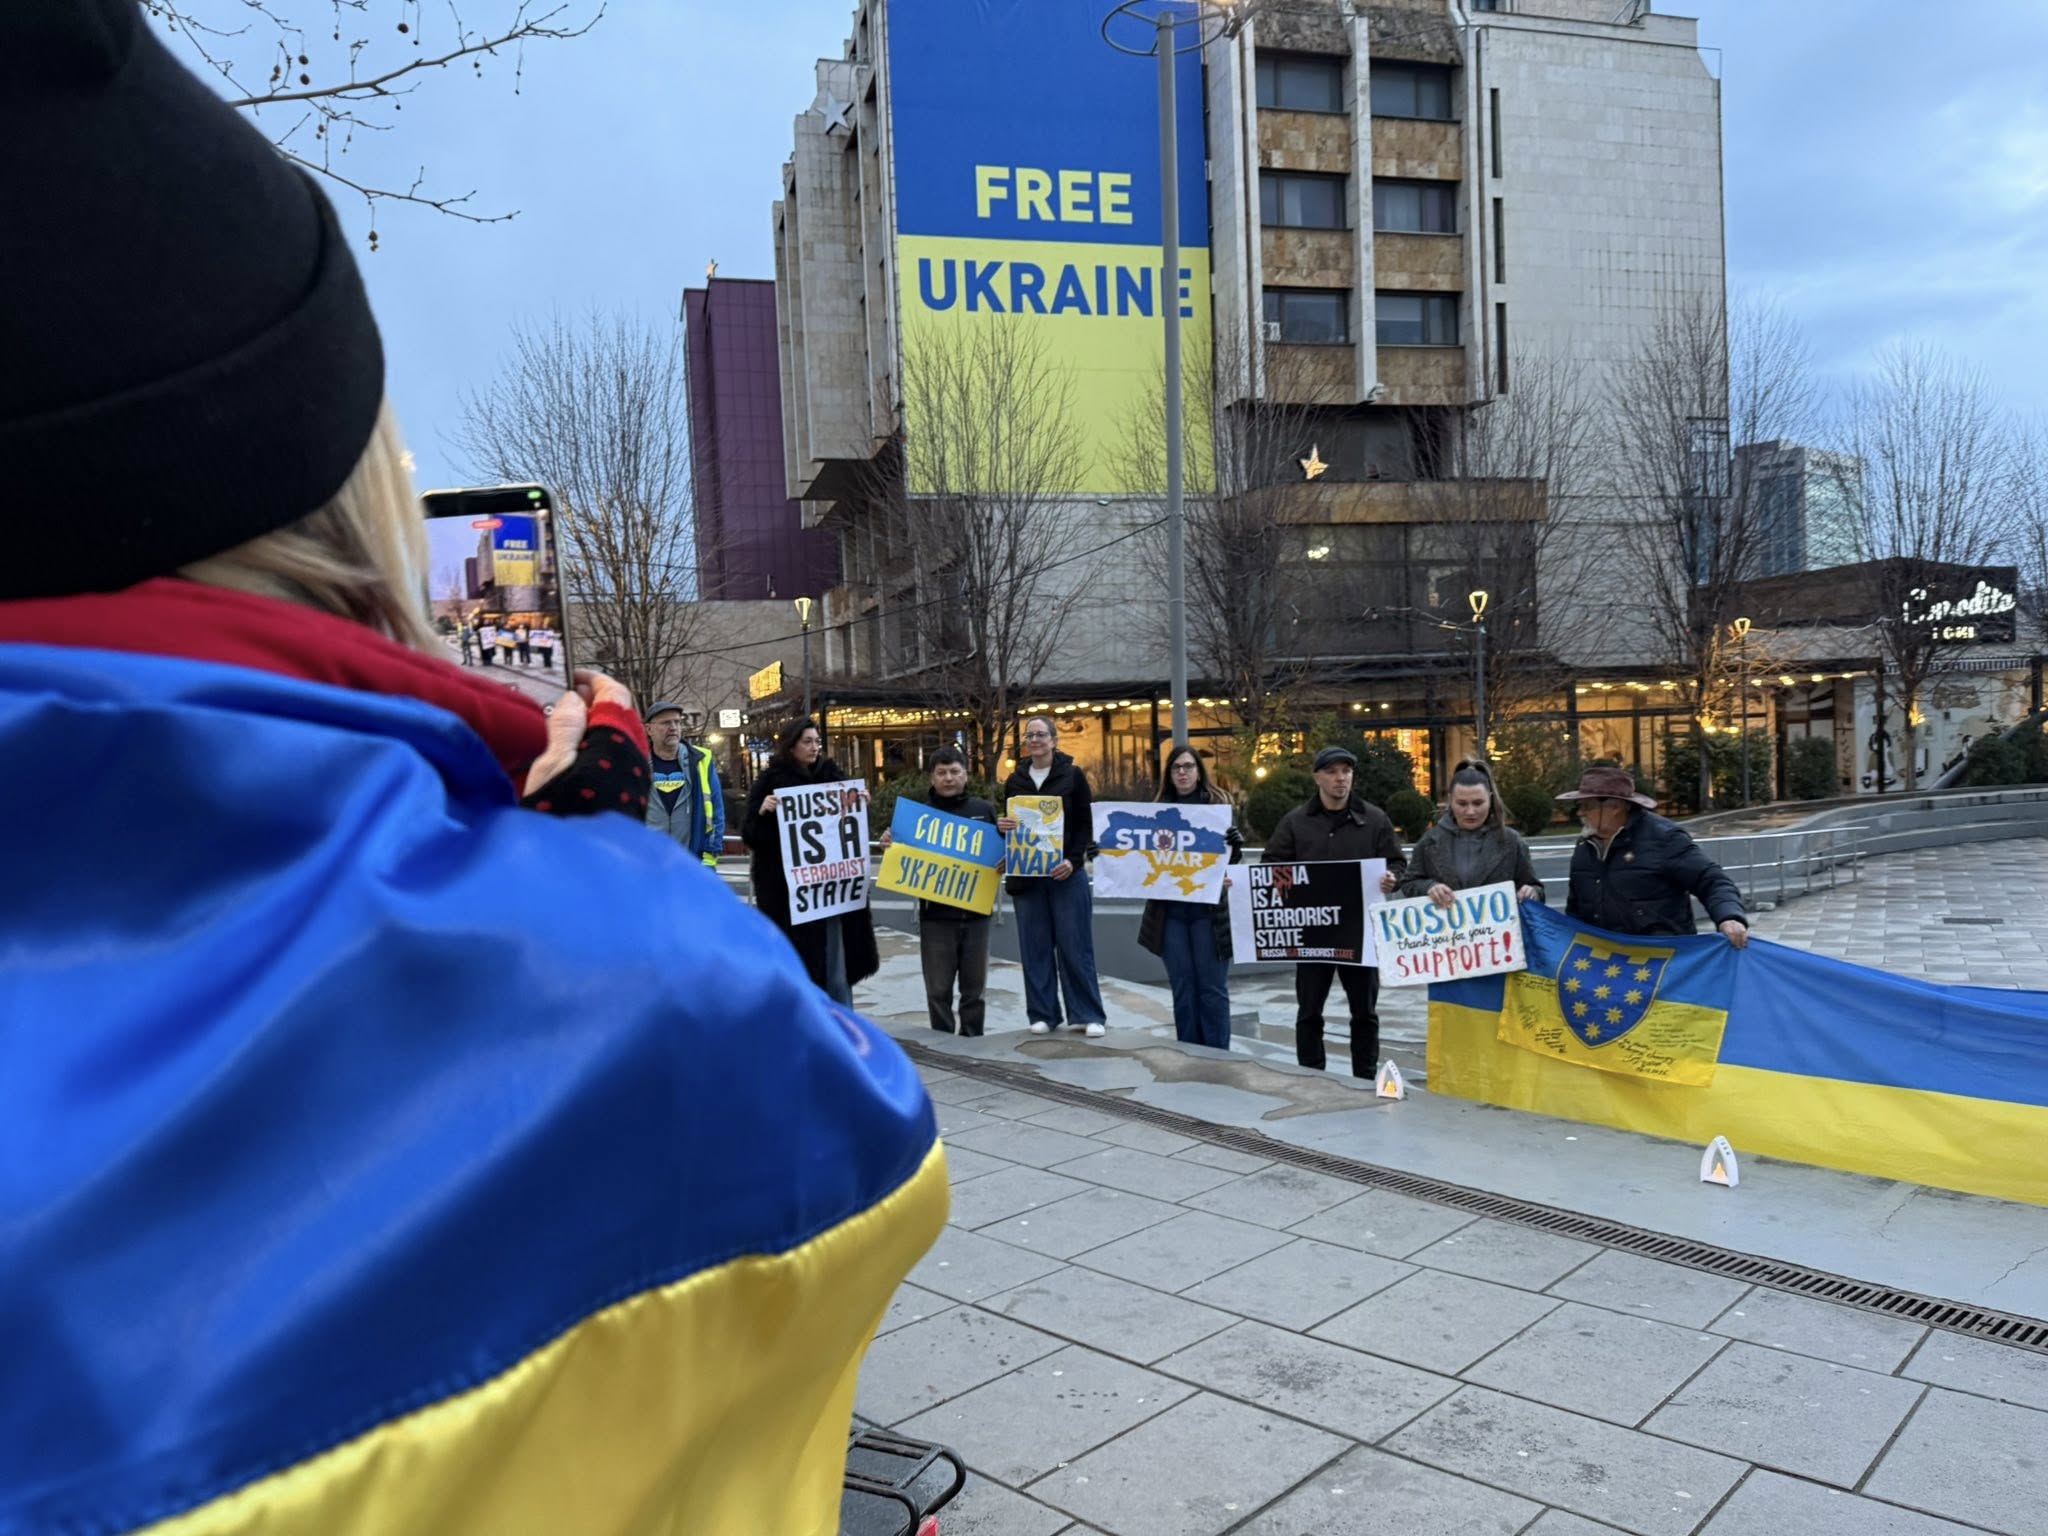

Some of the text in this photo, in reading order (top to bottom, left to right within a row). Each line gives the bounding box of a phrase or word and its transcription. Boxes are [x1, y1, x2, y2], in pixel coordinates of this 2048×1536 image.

[975, 165, 1133, 225] FREE
[782, 788, 861, 822] RUSSIA
[788, 816, 861, 867] IS A
[915, 814, 984, 856] СЛАВА
[1115, 828, 1196, 853] STOP
[791, 858, 865, 885] TERRORIST
[1007, 848, 1062, 875] WAR
[1153, 850, 1203, 867] WAR
[896, 856, 980, 903] УКРАЇНІ
[1250, 865, 1310, 888] RUSSIA
[796, 876, 865, 912] STATE
[1252, 887, 1283, 908] IS A
[1253, 905, 1342, 928] TERRORIST
[1255, 928, 1305, 948] STATE
[1397, 927, 1496, 950] thank you for your
